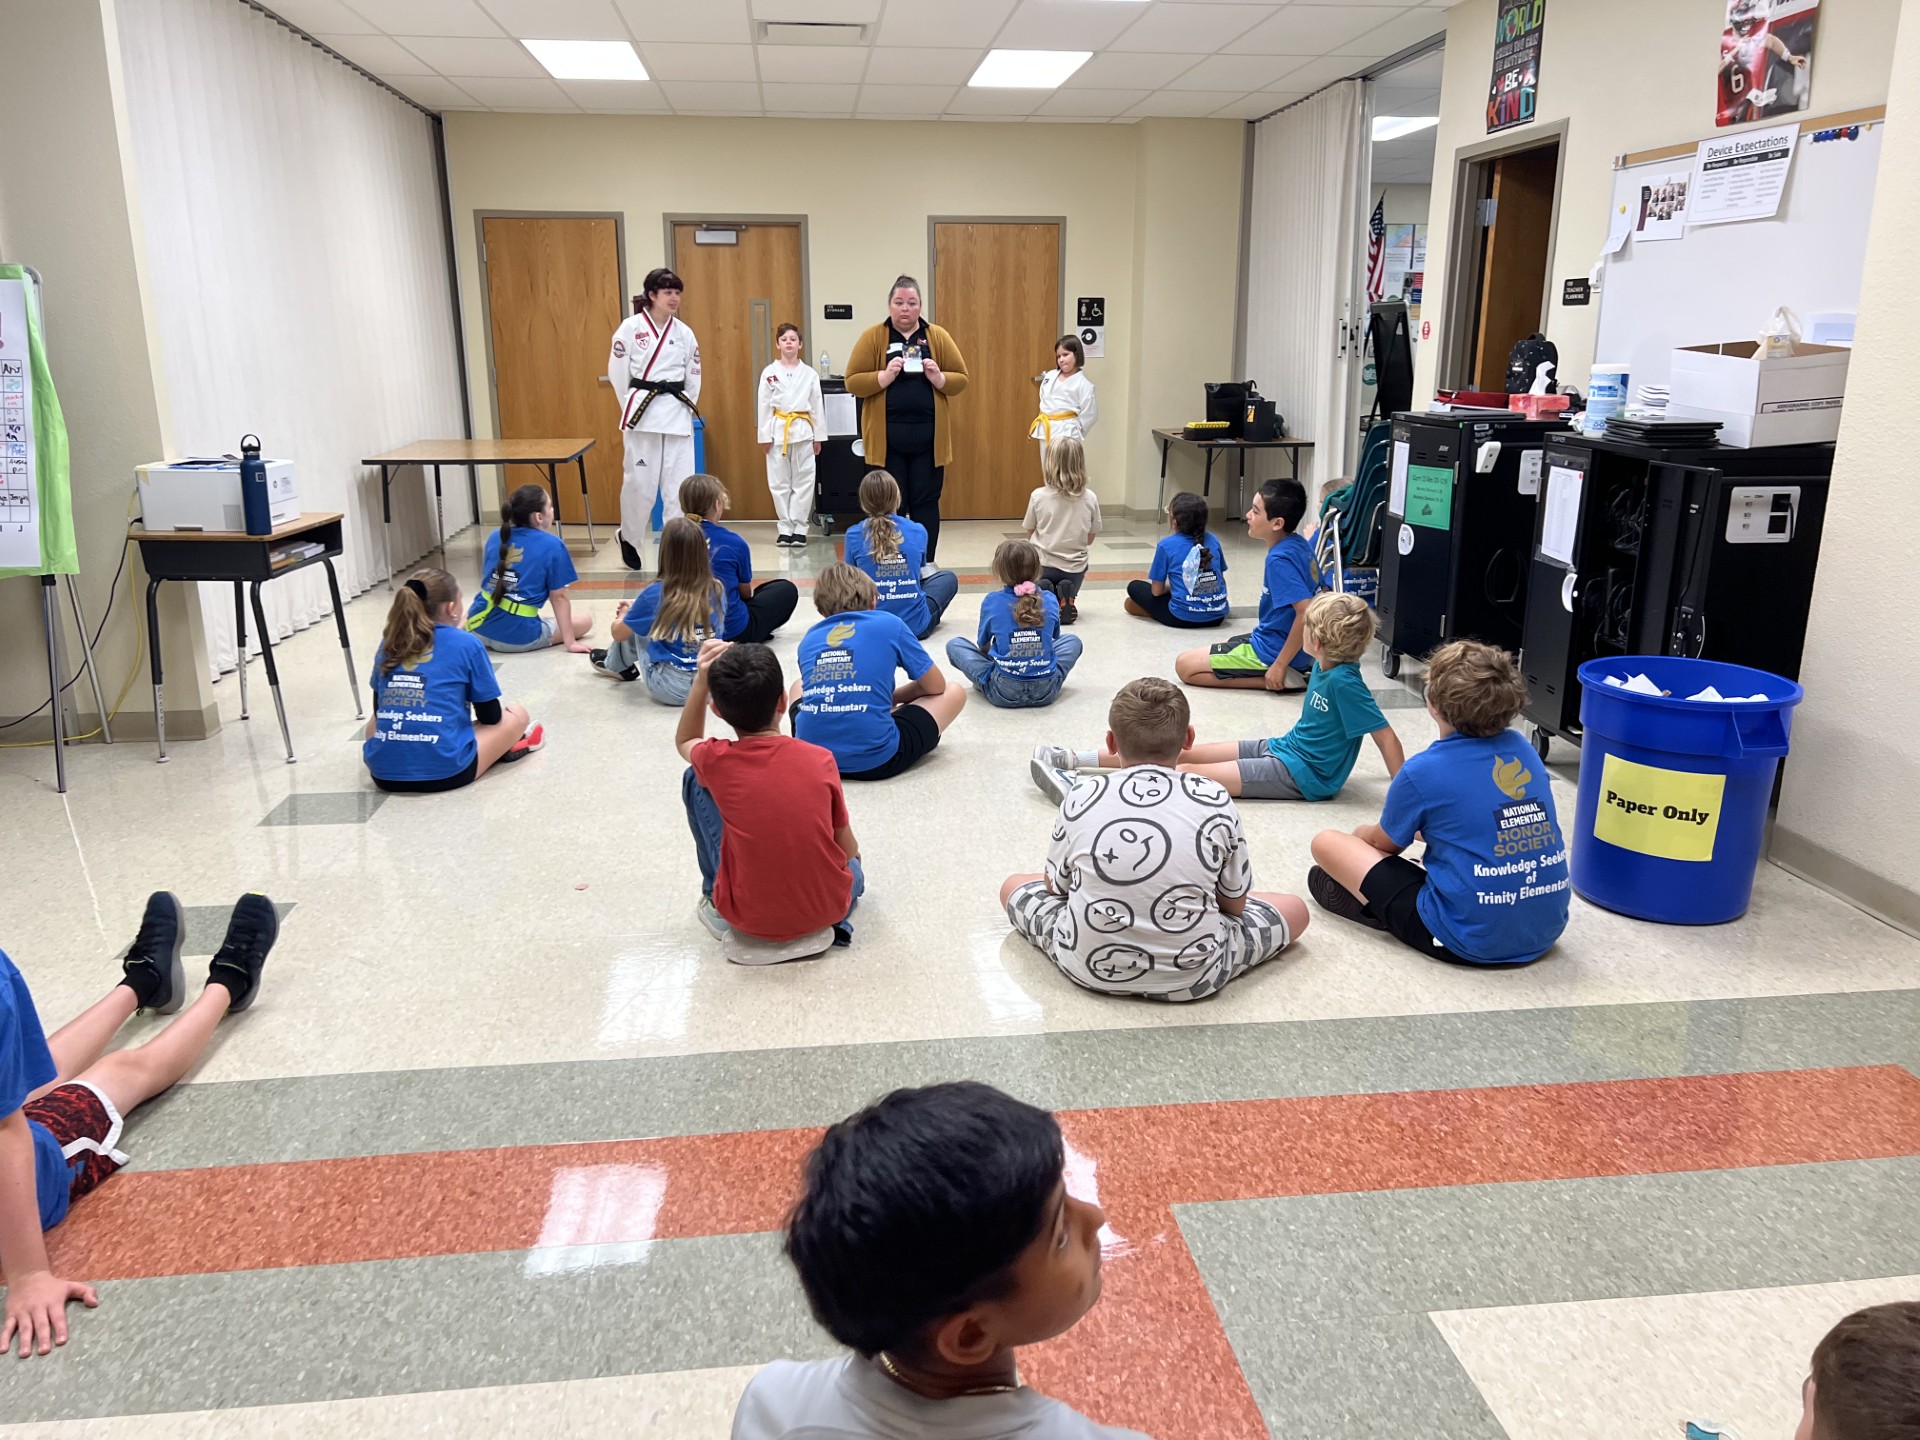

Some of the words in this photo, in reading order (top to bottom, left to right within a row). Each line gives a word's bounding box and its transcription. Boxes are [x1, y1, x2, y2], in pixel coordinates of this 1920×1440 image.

[1504, 68, 1520, 92] BE
[1731, 64, 1744, 93] 6
[1707, 145, 1733, 157] Device
[1735, 136, 1789, 154] Expectations
[875, 570, 909, 578] SOCIETY
[886, 592, 919, 600] Elementary
[1011, 636, 1041, 644] ELEMENTARY
[820, 650, 848, 658] NATIONAL
[813, 662, 854, 673] HONOR
[816, 656, 852, 666] ELEMENTARY
[391, 674, 421, 682] NATIONAL
[809, 670, 858, 683] SOCIETY
[387, 681, 425, 689] ELEMENTARY
[837, 683, 872, 693] Seekers
[824, 694, 835, 703] of
[1309, 690, 1329, 713] TES
[820, 703, 869, 712] Elementary
[405, 711, 443, 723] Seekers
[392, 721, 403, 730] of
[387, 730, 440, 744] Elementary
[1502, 802, 1541, 818] NATIONAL
[1606, 789, 1658, 816] Paper
[1662, 805, 1710, 826] Only
[1500, 811, 1546, 830] ELEMENTARY
[1496, 821, 1552, 843] HONOR
[1493, 832, 1556, 858] SOCIETY
[1473, 859, 1537, 877] Knowledge
[1525, 871, 1537, 884] of
[1476, 890, 1517, 905] Trinity
